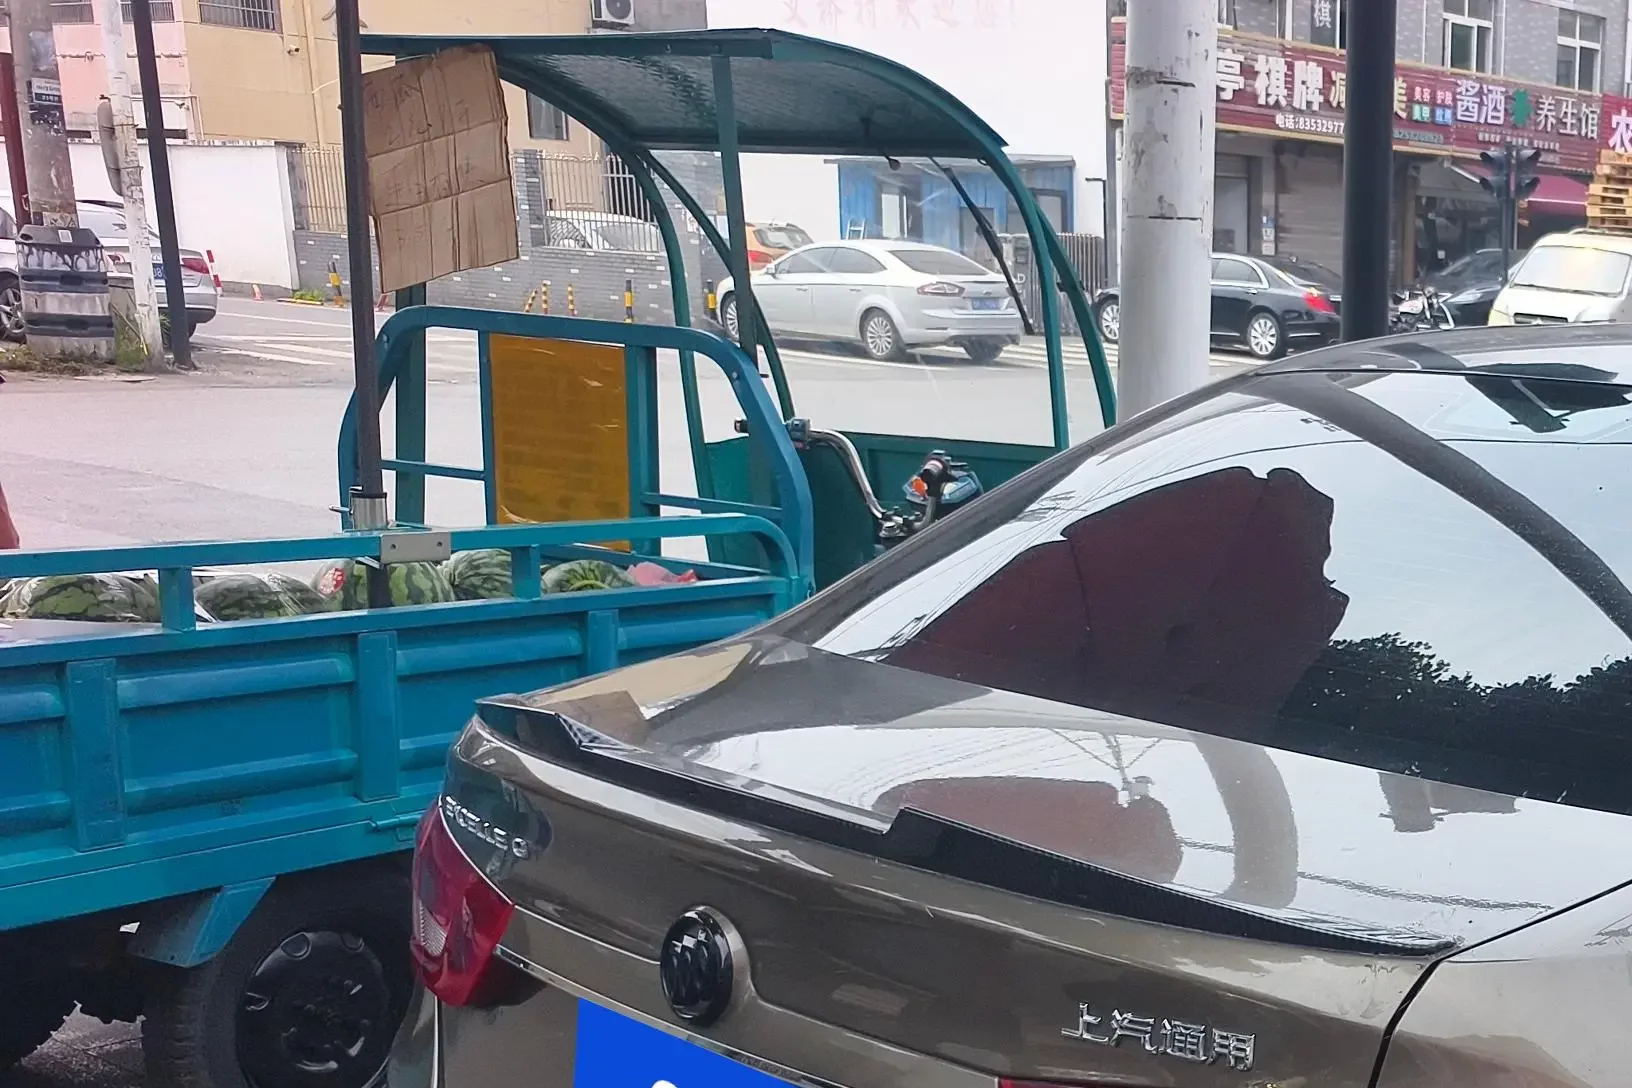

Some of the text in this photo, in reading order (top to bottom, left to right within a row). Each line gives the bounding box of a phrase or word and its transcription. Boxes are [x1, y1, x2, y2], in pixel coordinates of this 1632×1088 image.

[1456, 79, 1600, 140] 酱酒 养生馆
[1061, 1002, 1255, 1071] 上汽通用
